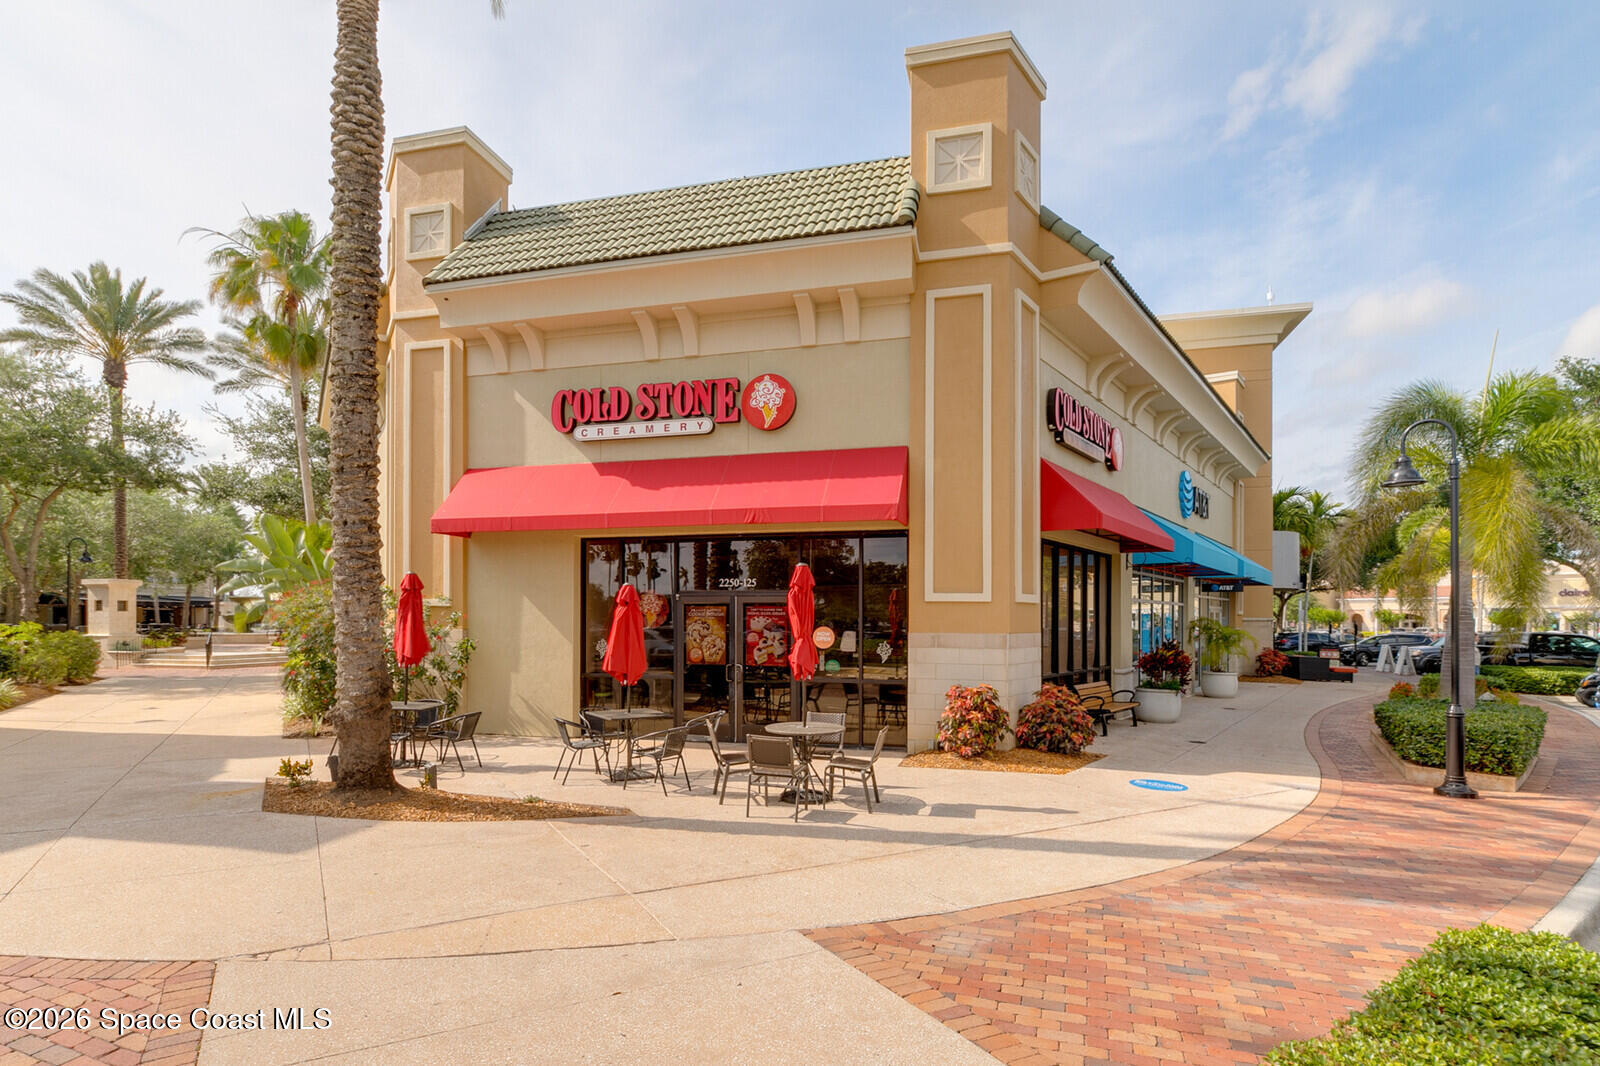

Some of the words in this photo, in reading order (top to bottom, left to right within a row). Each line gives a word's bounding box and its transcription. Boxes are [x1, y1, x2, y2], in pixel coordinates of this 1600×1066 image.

[551, 386, 632, 433] COLD
[634, 377, 741, 423] STONE
[1055, 387, 1082, 433] COLD
[1083, 406, 1112, 459] STONE
[580, 421, 706, 438] CREAMERY
[719, 577, 757, 587] 2250-125
